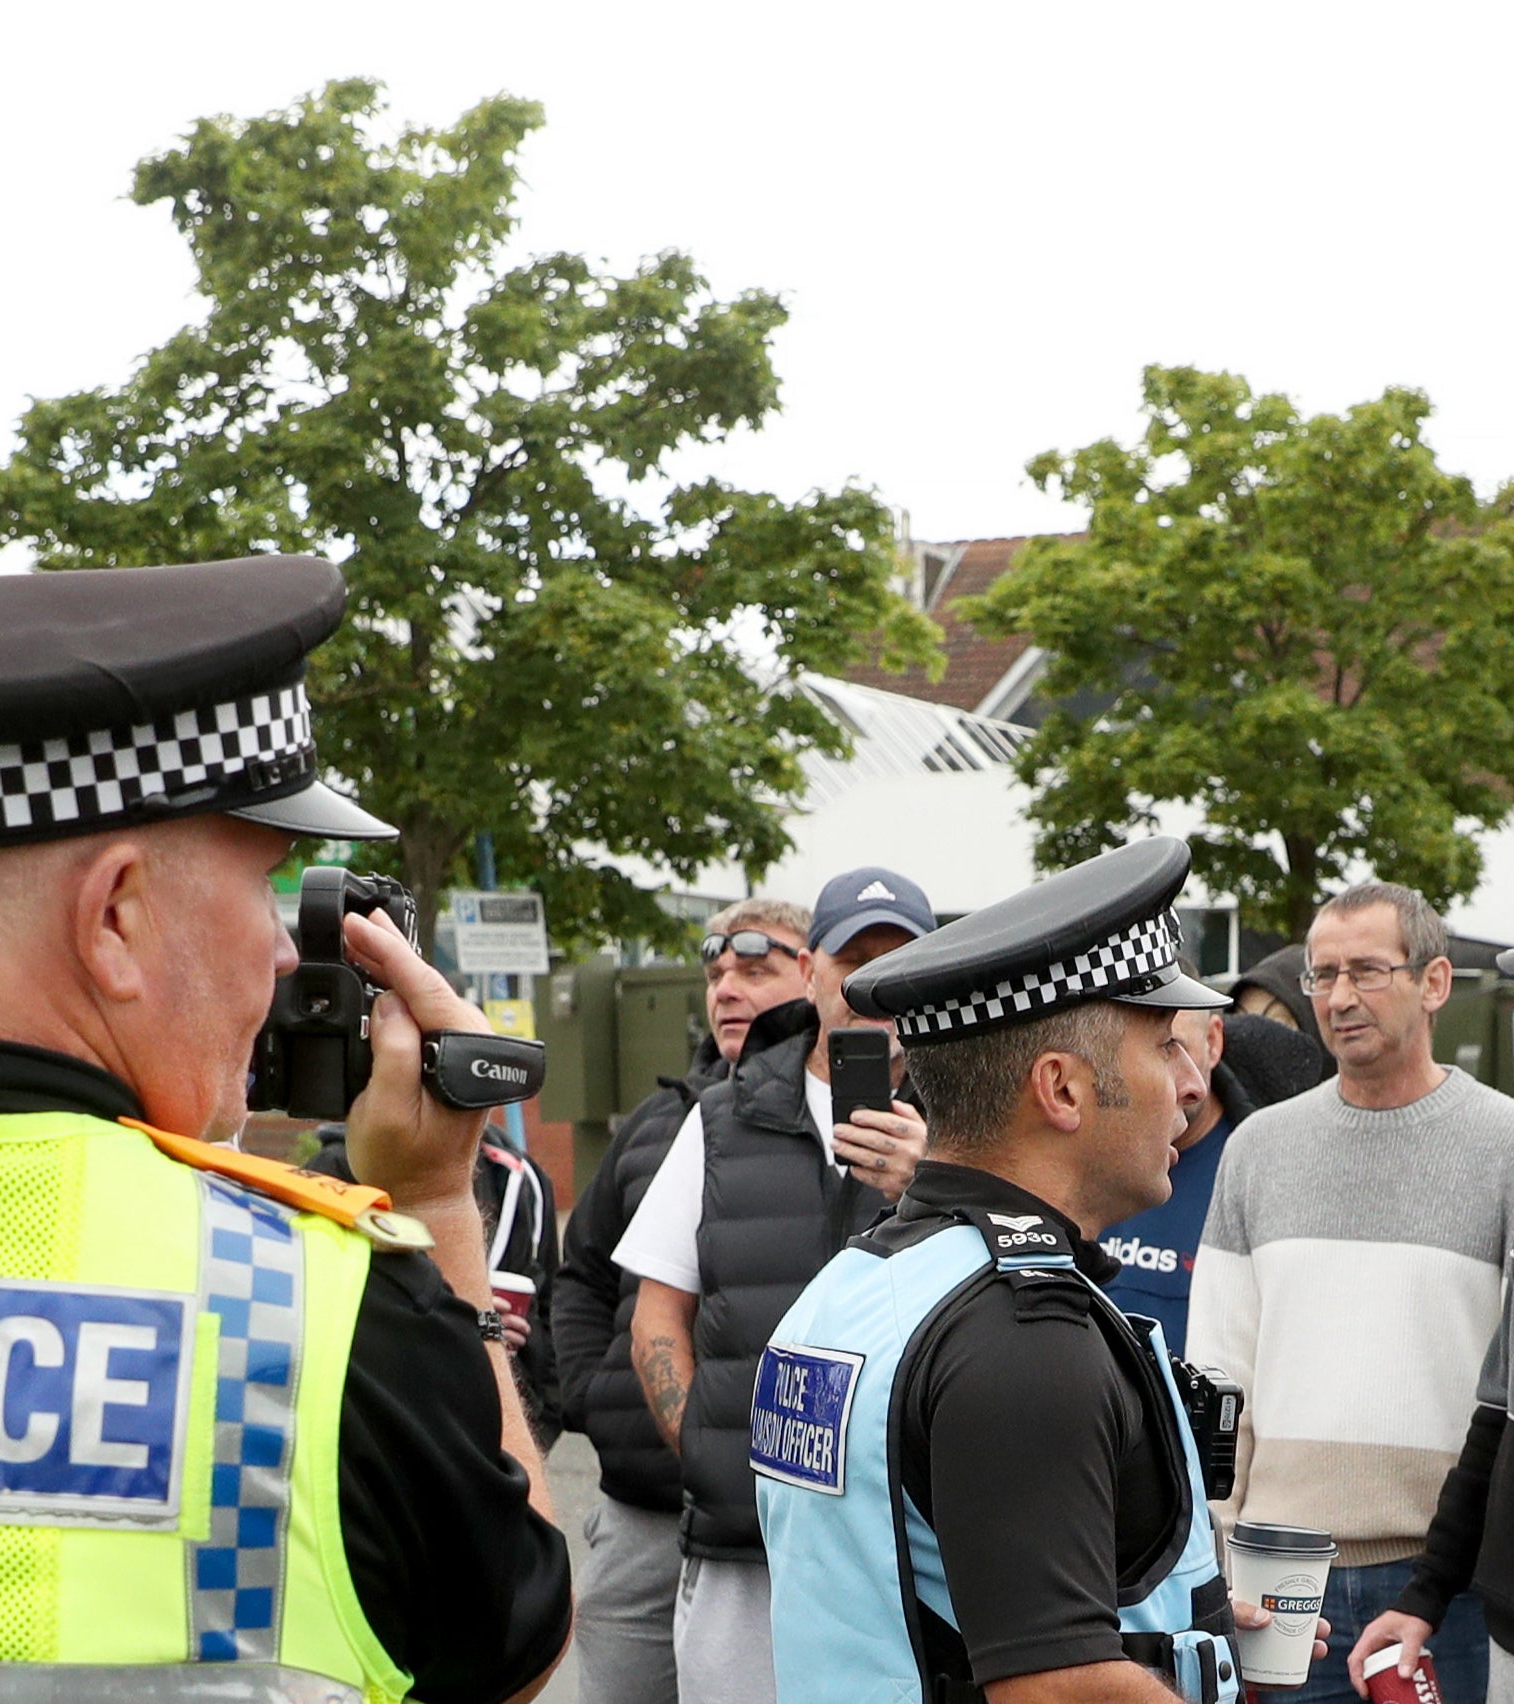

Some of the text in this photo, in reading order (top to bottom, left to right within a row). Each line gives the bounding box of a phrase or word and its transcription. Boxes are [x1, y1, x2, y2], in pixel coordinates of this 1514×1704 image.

[471, 1059, 527, 1085] Canon
[998, 1231, 1057, 1248] 5930
[1099, 1237, 1178, 1272] didas
[782, 1415, 834, 1473] OFFICER
[1278, 1600, 1321, 1611] GREGGS
